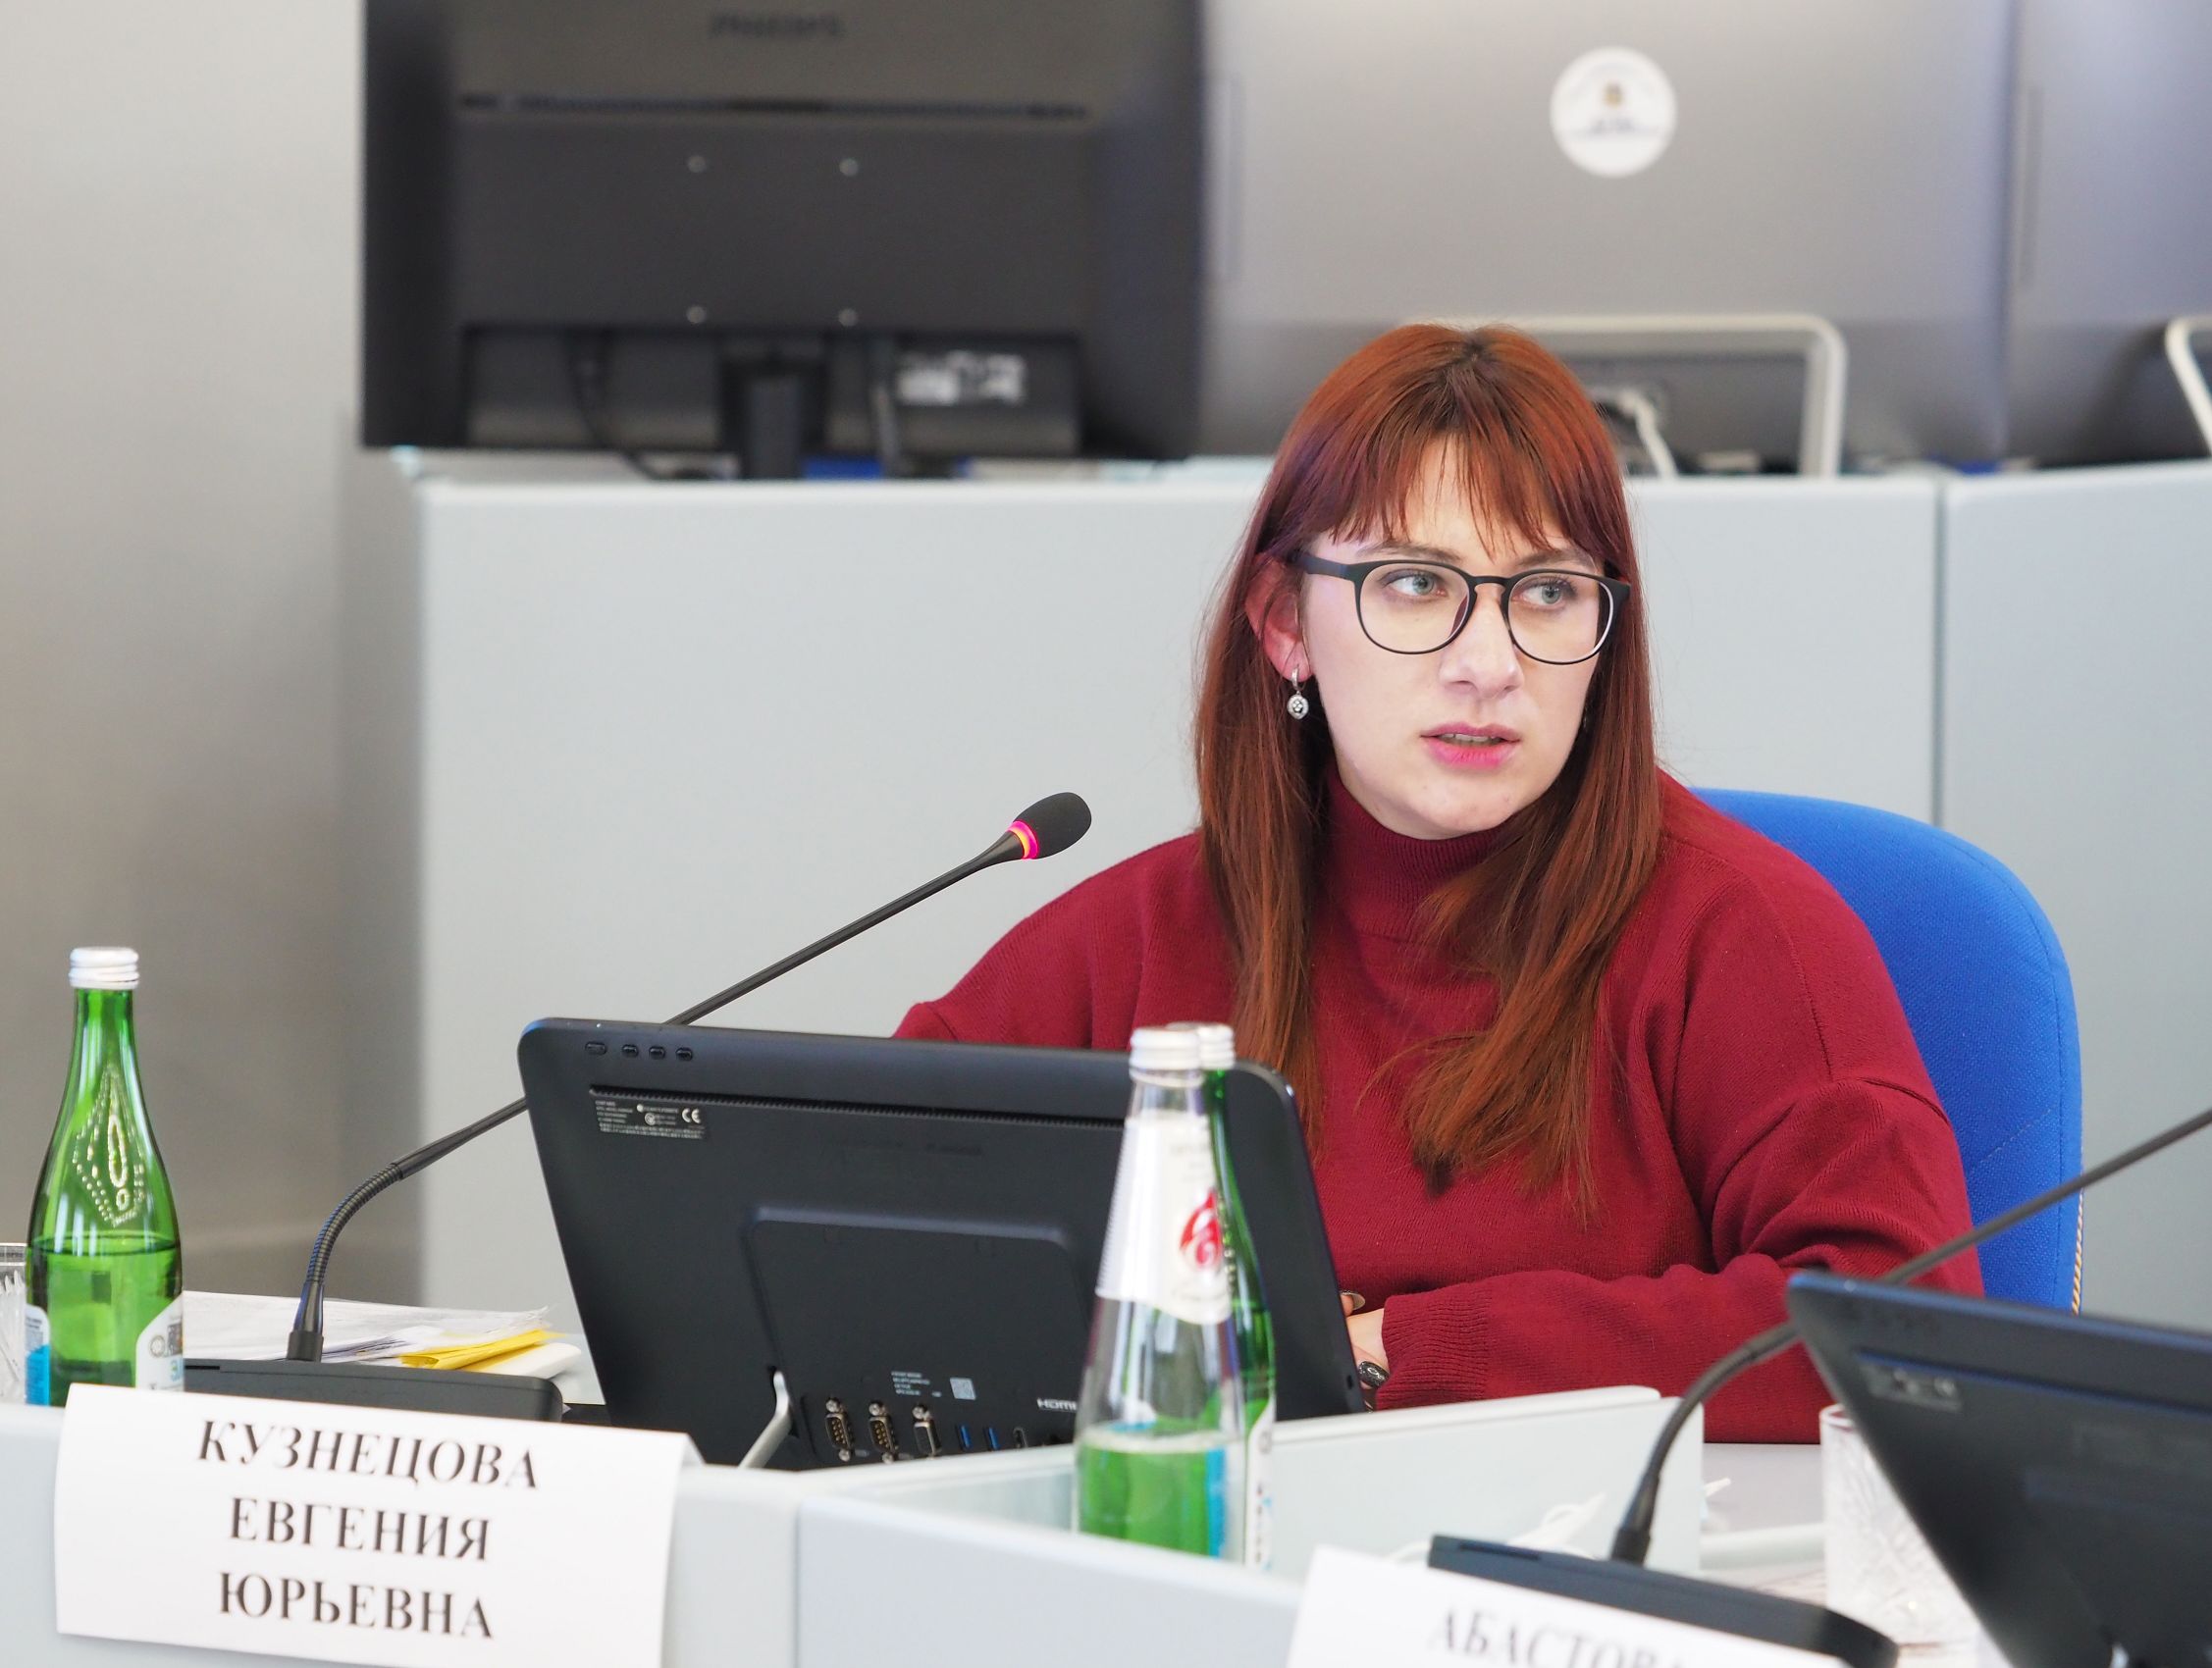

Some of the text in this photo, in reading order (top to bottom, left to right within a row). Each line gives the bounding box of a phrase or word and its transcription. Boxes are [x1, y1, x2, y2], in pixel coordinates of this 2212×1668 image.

[197, 1419, 538, 1489] КУЗНЕЦОВА
[230, 1496, 491, 1561] ЕВГЕНИЯ
[220, 1572, 494, 1640] ЮРЬЕВНА
[1430, 1609, 1681, 1668] АБАСТОВ
